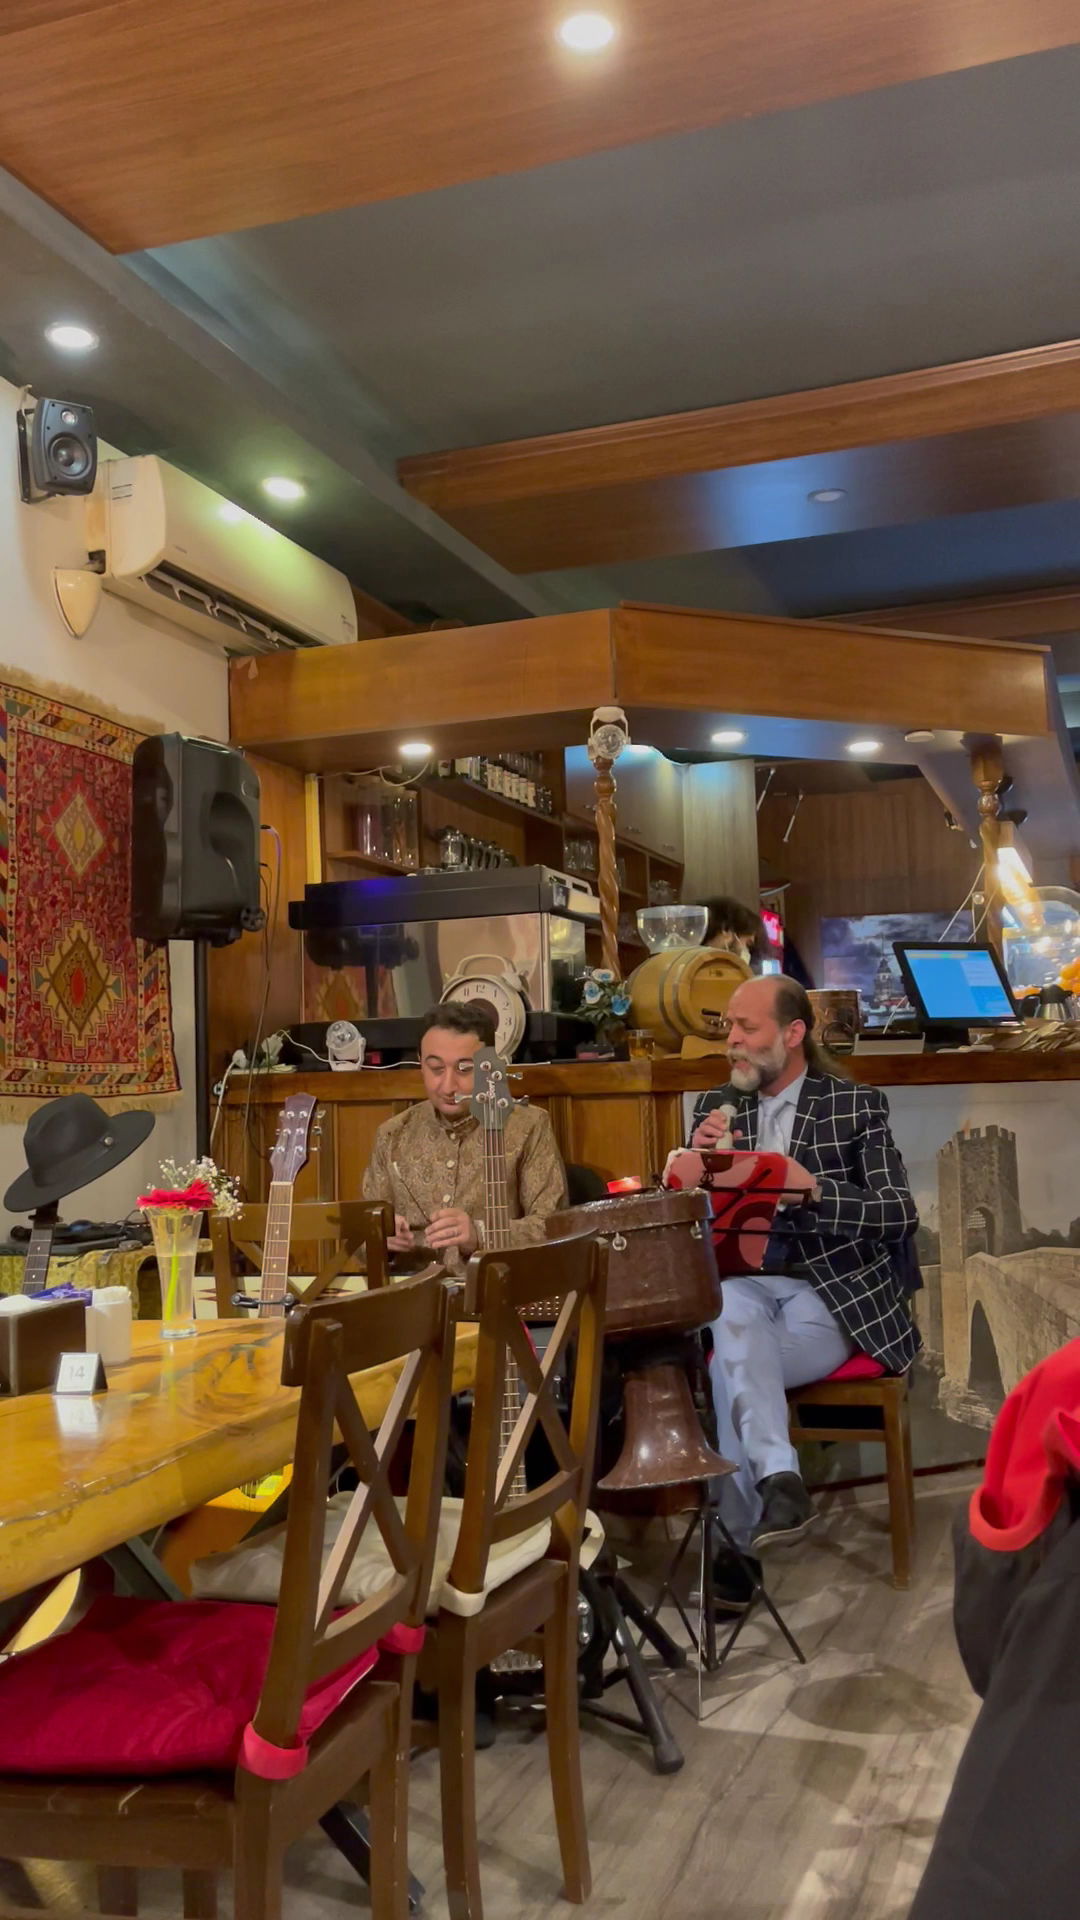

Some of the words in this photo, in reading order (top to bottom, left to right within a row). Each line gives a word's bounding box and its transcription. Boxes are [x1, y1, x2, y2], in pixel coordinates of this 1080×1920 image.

[475, 984, 485, 993] 12
[493, 988, 498, 998] 1
[502, 1001, 509, 1010] 2
[504, 1017, 512, 1026] 3
[69, 1365, 85, 1380] 14
